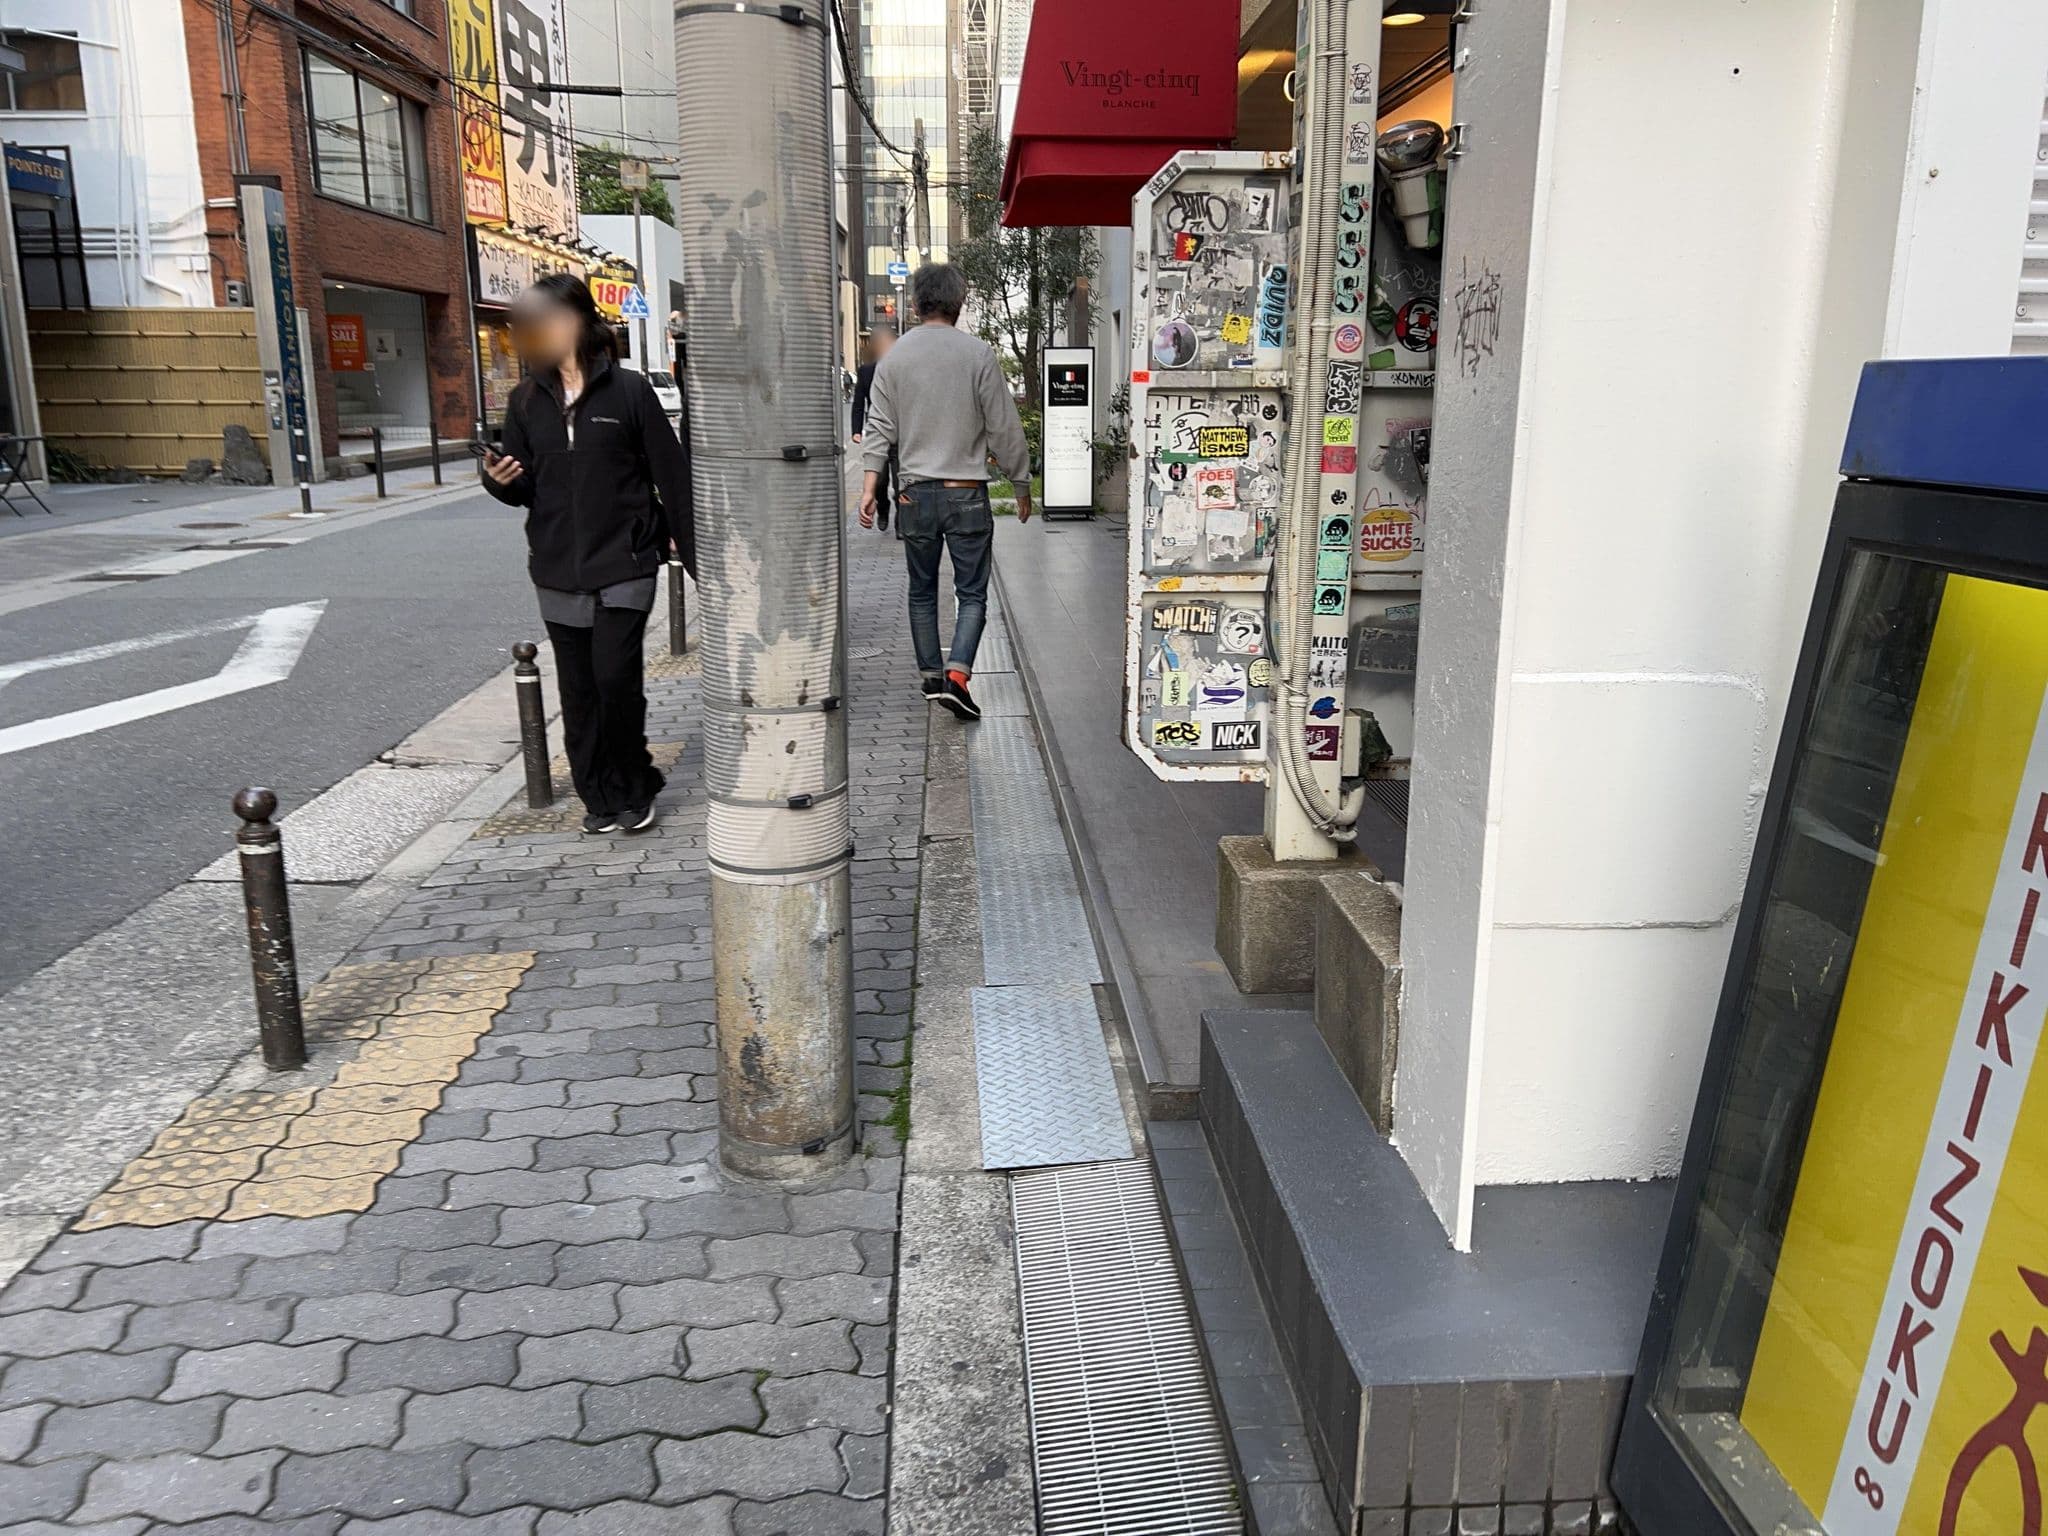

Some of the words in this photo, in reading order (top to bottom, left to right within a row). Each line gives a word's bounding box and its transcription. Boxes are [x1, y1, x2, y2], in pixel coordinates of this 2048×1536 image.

[1060, 60, 1200, 97] Vingt-cinq
[1102, 99, 1157, 109] BLANCHE
[1261, 265, 1287, 348] QUIDZ
[331, 329, 359, 342] SALE
[1199, 469, 1233, 482] FOES
[1361, 536, 1413, 551] SUCKS
[1153, 606, 1211, 633] SNATCH
[1312, 636, 1348, 649] KAITO
[1215, 724, 1257, 746] NICK
